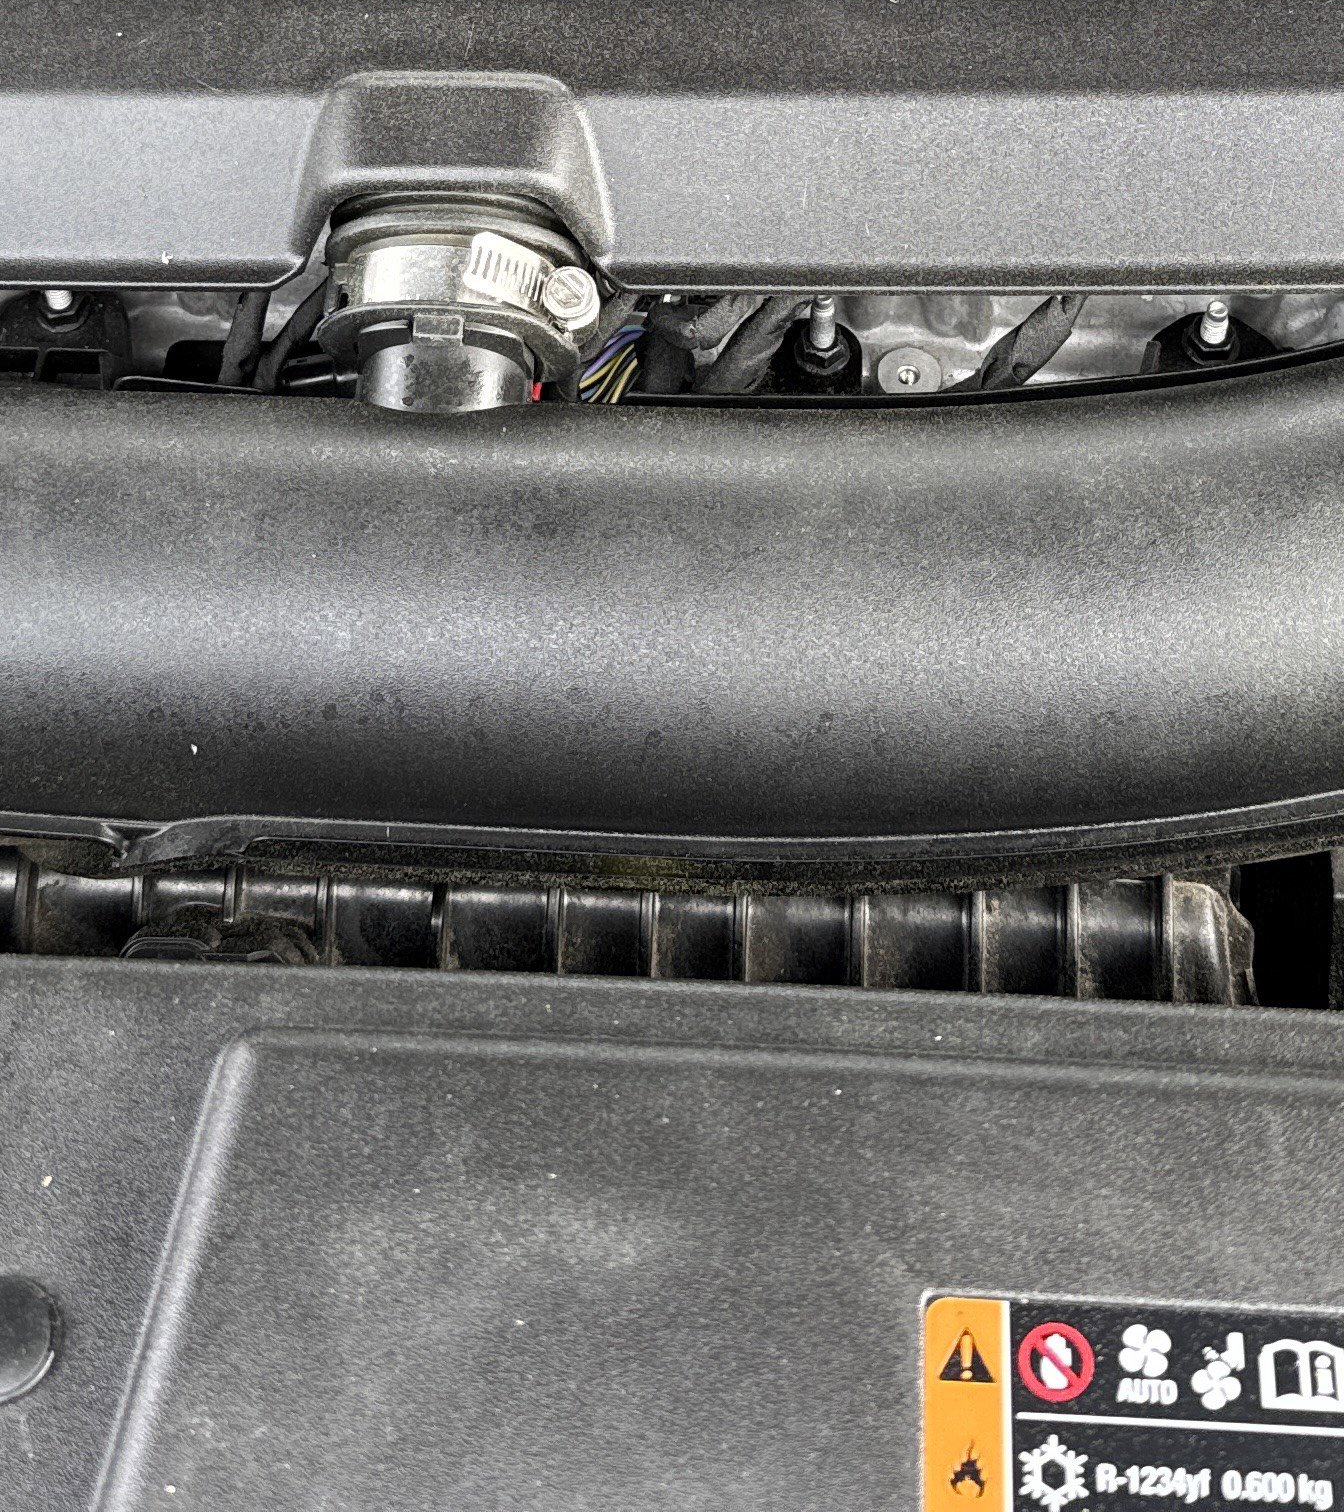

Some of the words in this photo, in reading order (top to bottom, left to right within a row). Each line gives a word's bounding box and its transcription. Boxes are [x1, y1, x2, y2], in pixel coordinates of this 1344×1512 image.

[1115, 1377, 1179, 1406] AUTO
[1095, 1461, 1212, 1504] R-1234yf
[1220, 1471, 1296, 1502] 0.600
[1297, 1472, 1334, 1511] kg
